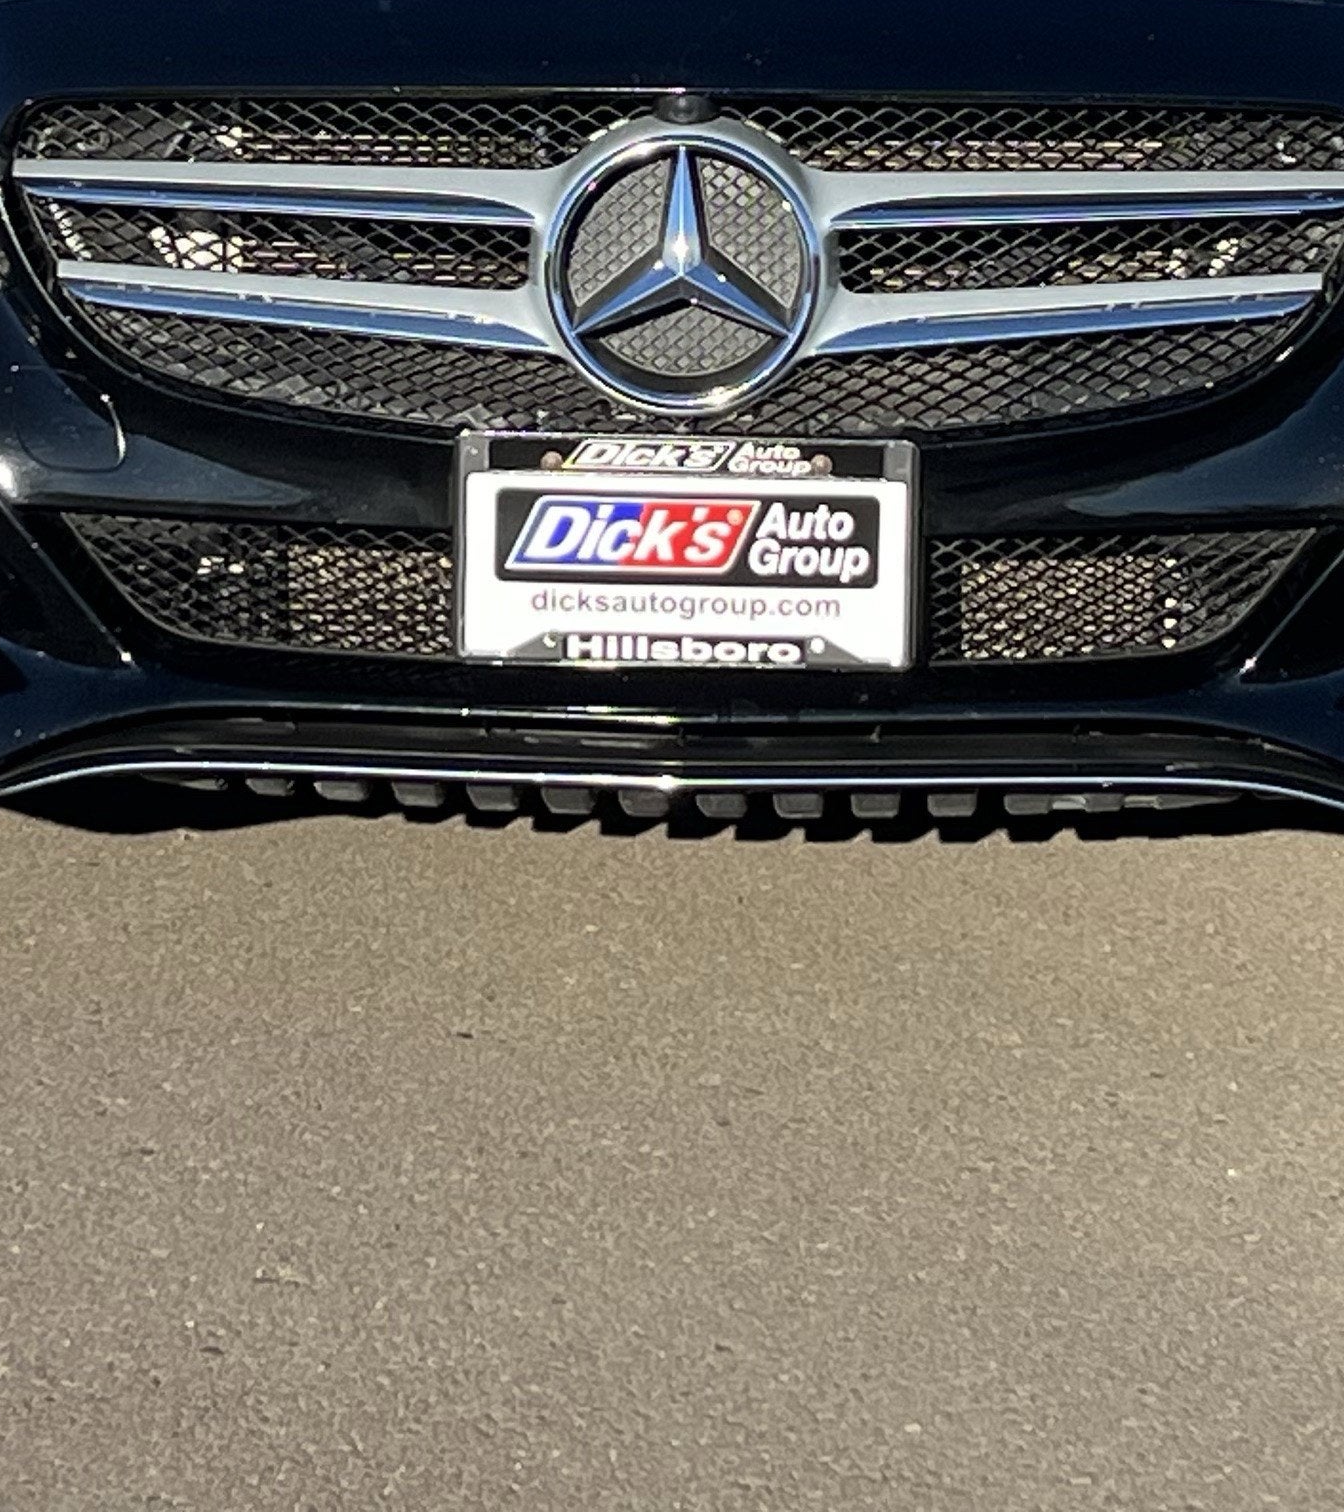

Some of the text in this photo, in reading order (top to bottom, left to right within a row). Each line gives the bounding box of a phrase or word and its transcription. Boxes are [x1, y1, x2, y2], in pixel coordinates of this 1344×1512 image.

[738, 441, 801, 460] Auto
[727, 458, 812, 476] Group
[755, 502, 854, 541] Auto
[748, 538, 870, 584] Group
[531, 589, 841, 620] dicksautogroup.com
[566, 634, 801, 663] Hillsboro
